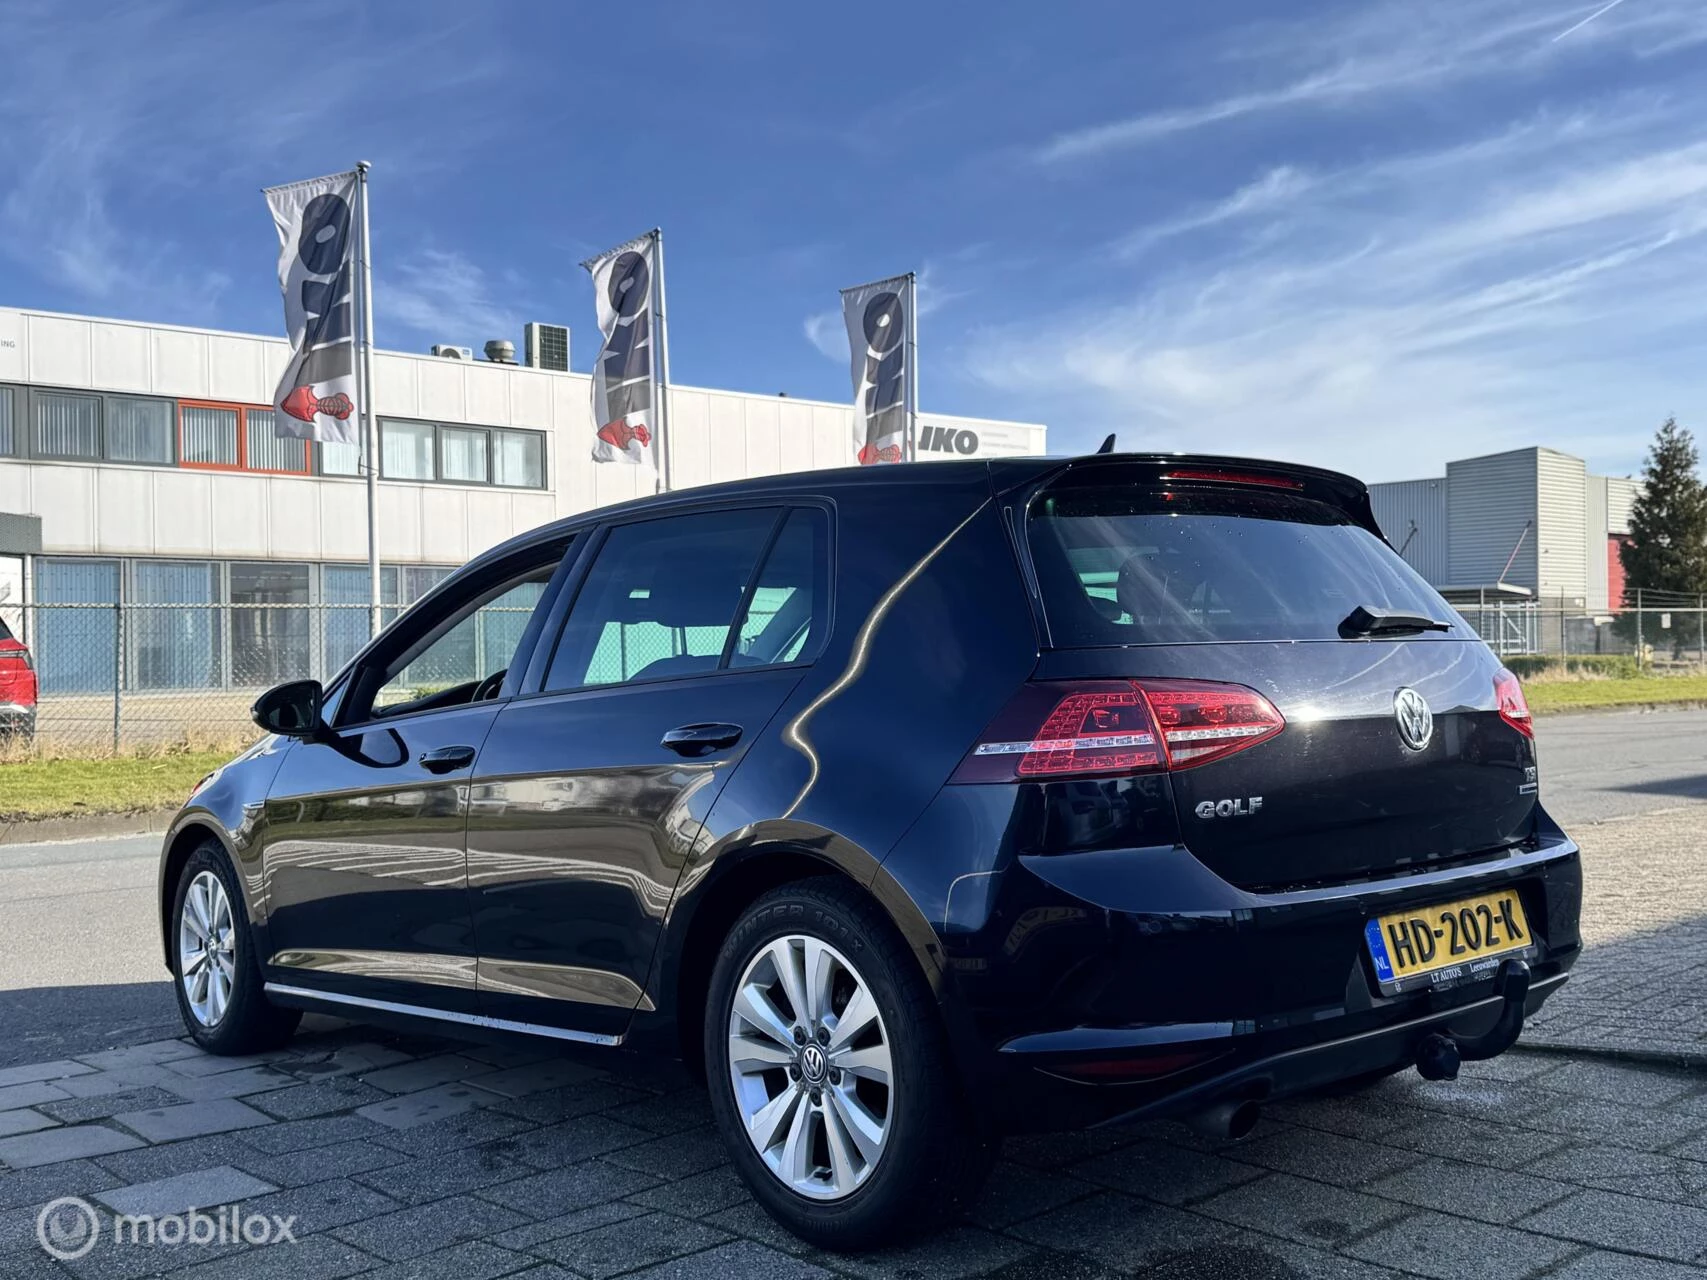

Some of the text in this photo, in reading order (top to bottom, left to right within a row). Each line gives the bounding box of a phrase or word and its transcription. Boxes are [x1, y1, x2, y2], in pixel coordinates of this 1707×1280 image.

[917, 425, 979, 455] IKO
[1195, 796, 1263, 819] GOLF
[724, 904, 804, 958] WINTER
[1387, 898, 1524, 968] HD-202-K
[1375, 955, 1389, 970] NL
[1430, 972, 1440, 983] LT
